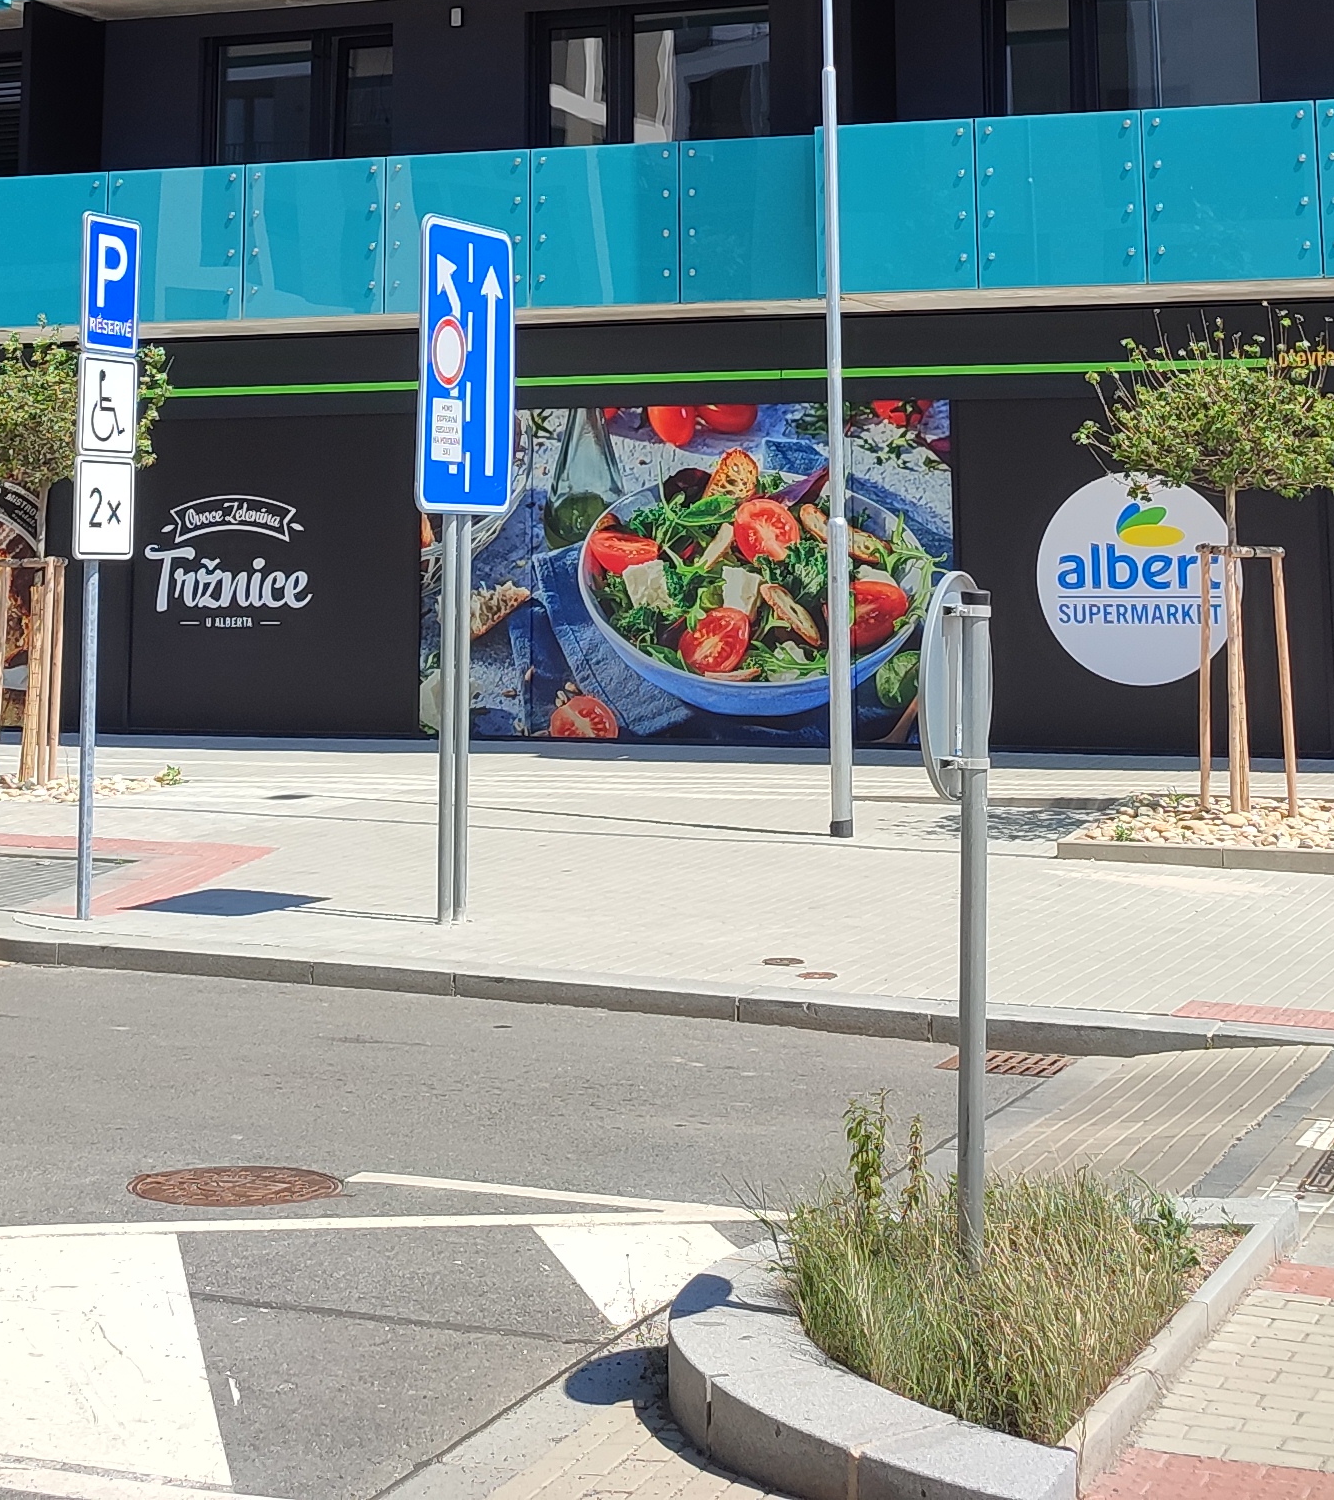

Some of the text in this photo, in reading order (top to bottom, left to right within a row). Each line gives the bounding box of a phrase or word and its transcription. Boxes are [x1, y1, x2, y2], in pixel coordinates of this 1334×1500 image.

[96, 233, 128, 308] P
[89, 312, 133, 338] RÉSERVÉ
[88, 487, 122, 529] 2x
[184, 508, 224, 529] Ovoce
[144, 544, 314, 613] Tržnice
[205, 616, 253, 628] U ALBERTA
[1058, 603, 1222, 625] SUPERMARKT
